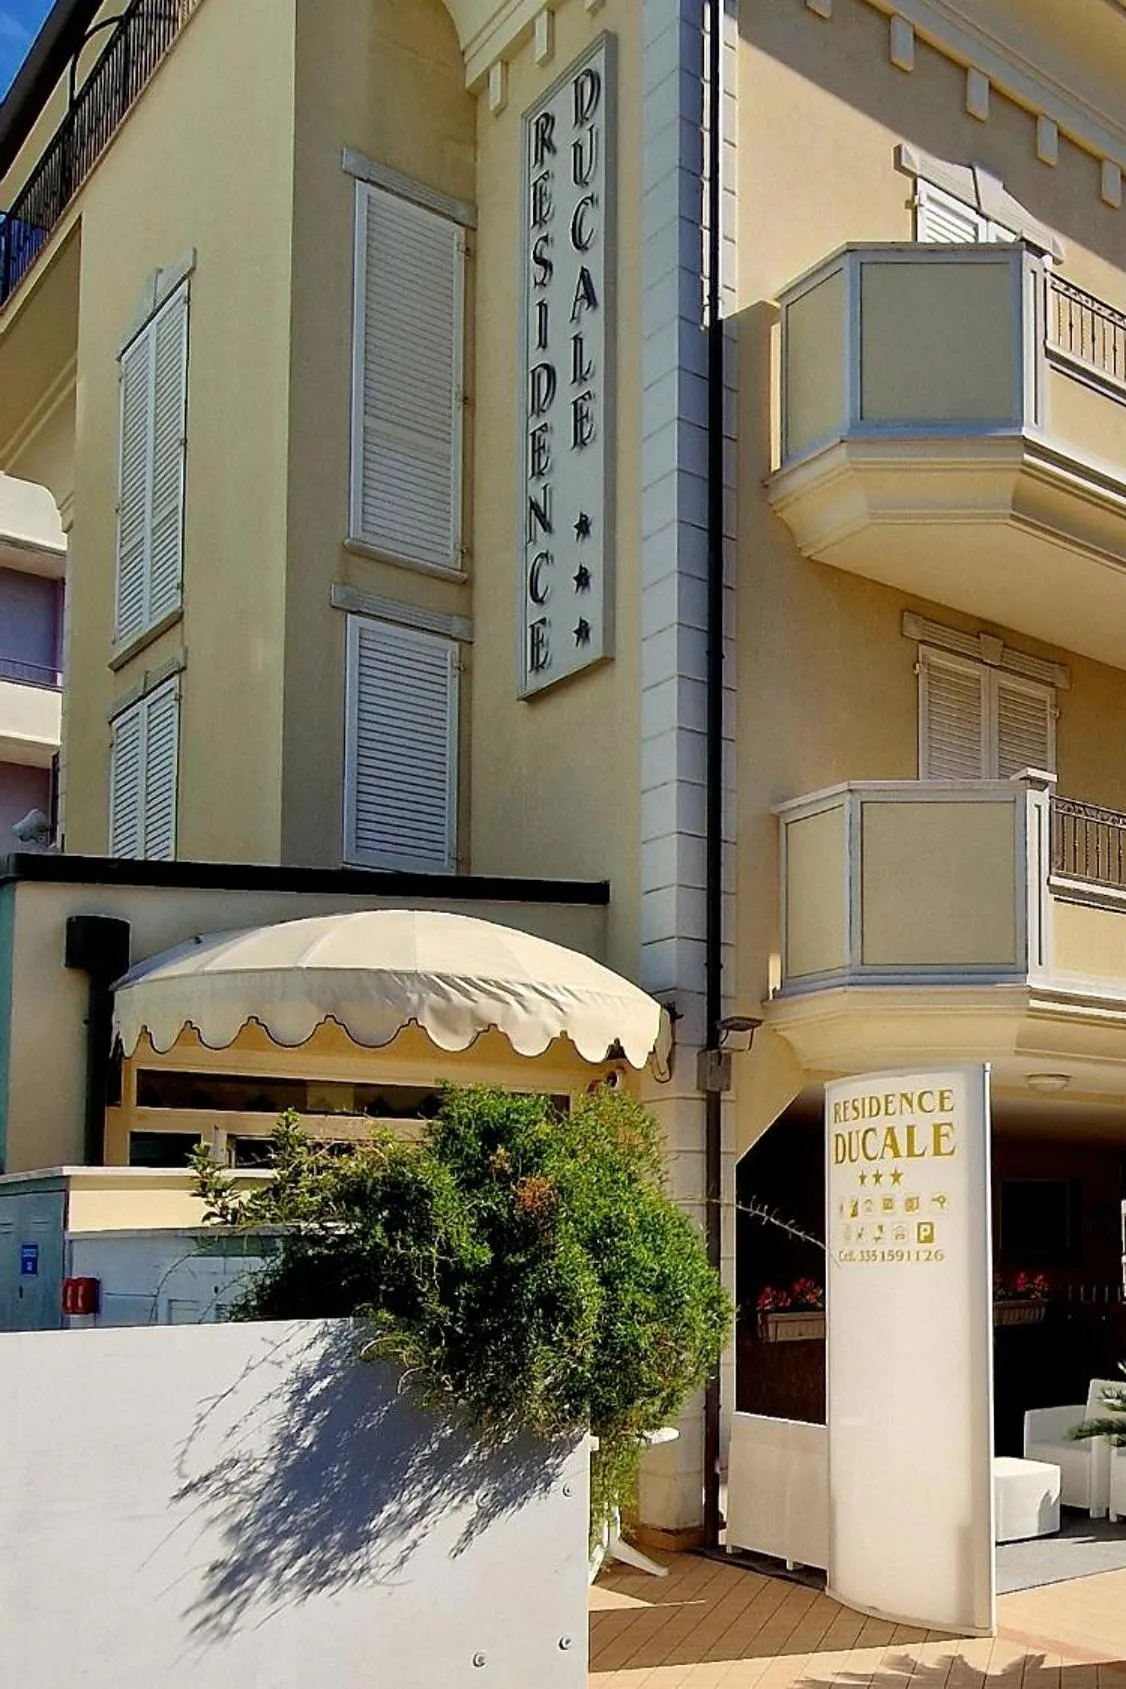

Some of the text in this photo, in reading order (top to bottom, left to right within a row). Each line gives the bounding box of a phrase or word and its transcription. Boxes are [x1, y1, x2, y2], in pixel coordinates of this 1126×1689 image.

[570, 67, 600, 451] DUCALE
[528, 111, 556, 675] RESIDENCE
[833, 1089, 955, 1124] RESIDENCE
[833, 1122, 958, 1165] DUCALE
